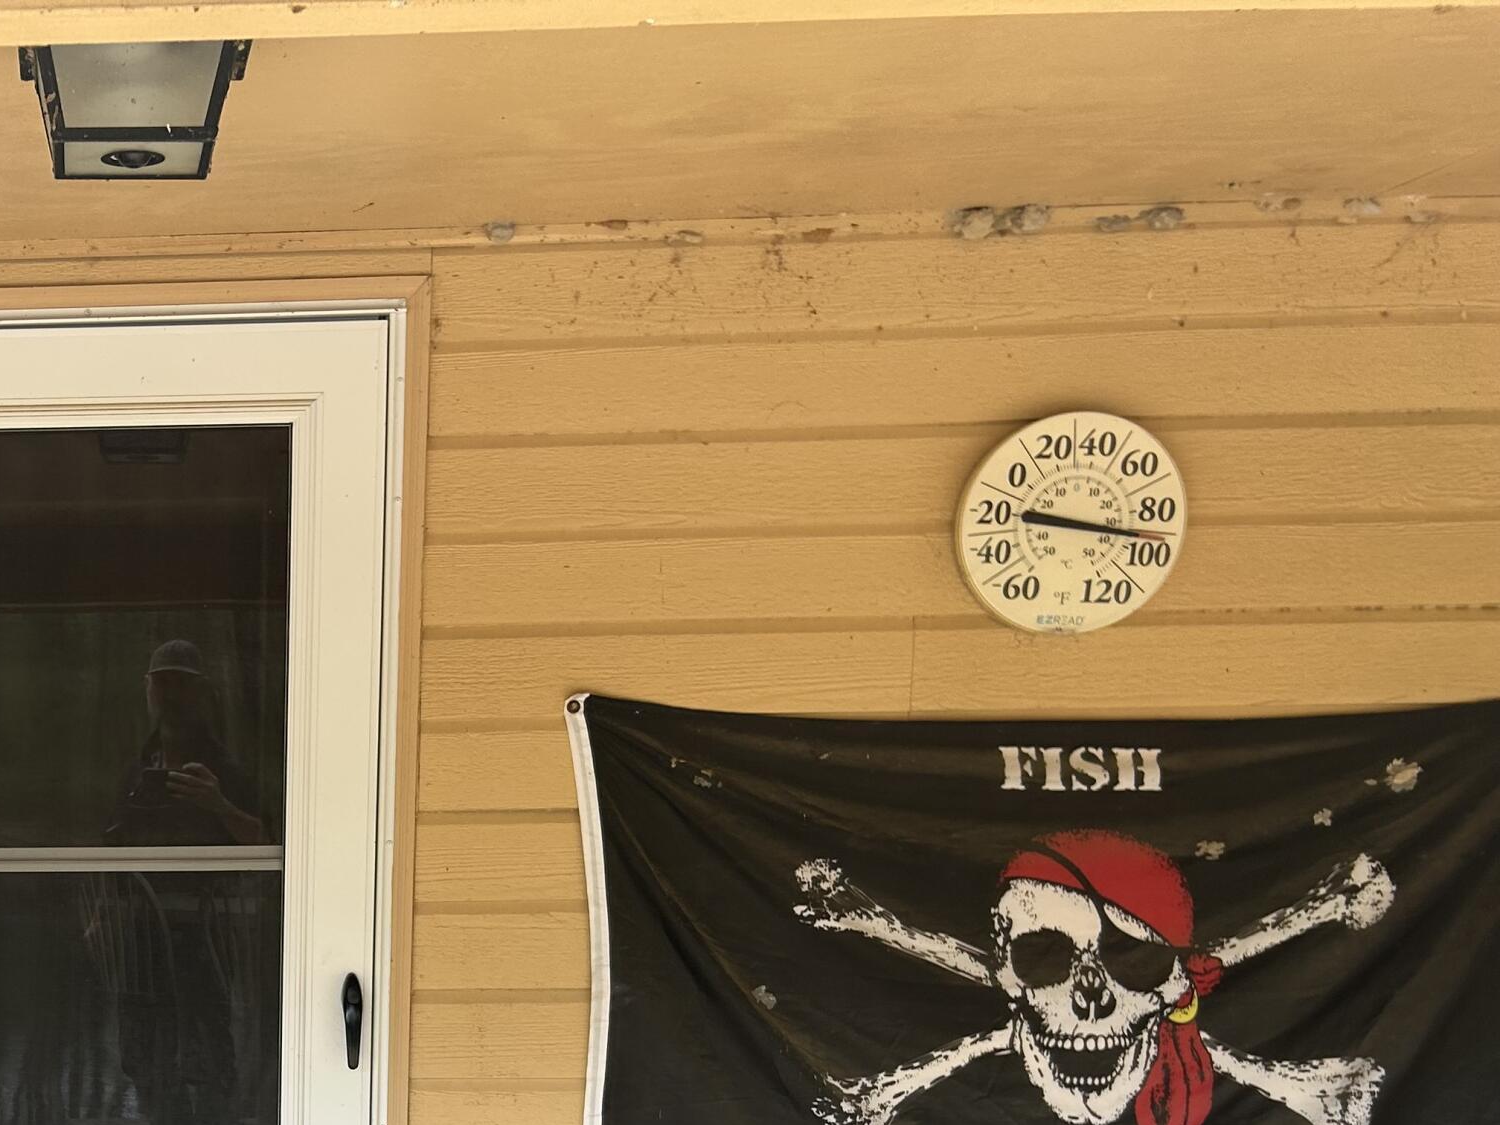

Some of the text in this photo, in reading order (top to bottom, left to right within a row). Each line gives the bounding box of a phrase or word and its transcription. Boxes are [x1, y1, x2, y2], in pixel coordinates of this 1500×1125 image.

[1035, 435, 1072, 460] 20
[1079, 429, 1117, 457] 40
[1008, 463, 1027, 488] 0
[1121, 449, 1159, 477] 60
[1138, 497, 1176, 522] 80
[1126, 542, 1171, 567] 100
[1080, 579, 1132, 604] 120
[997, 745, 1163, 792] FISH
